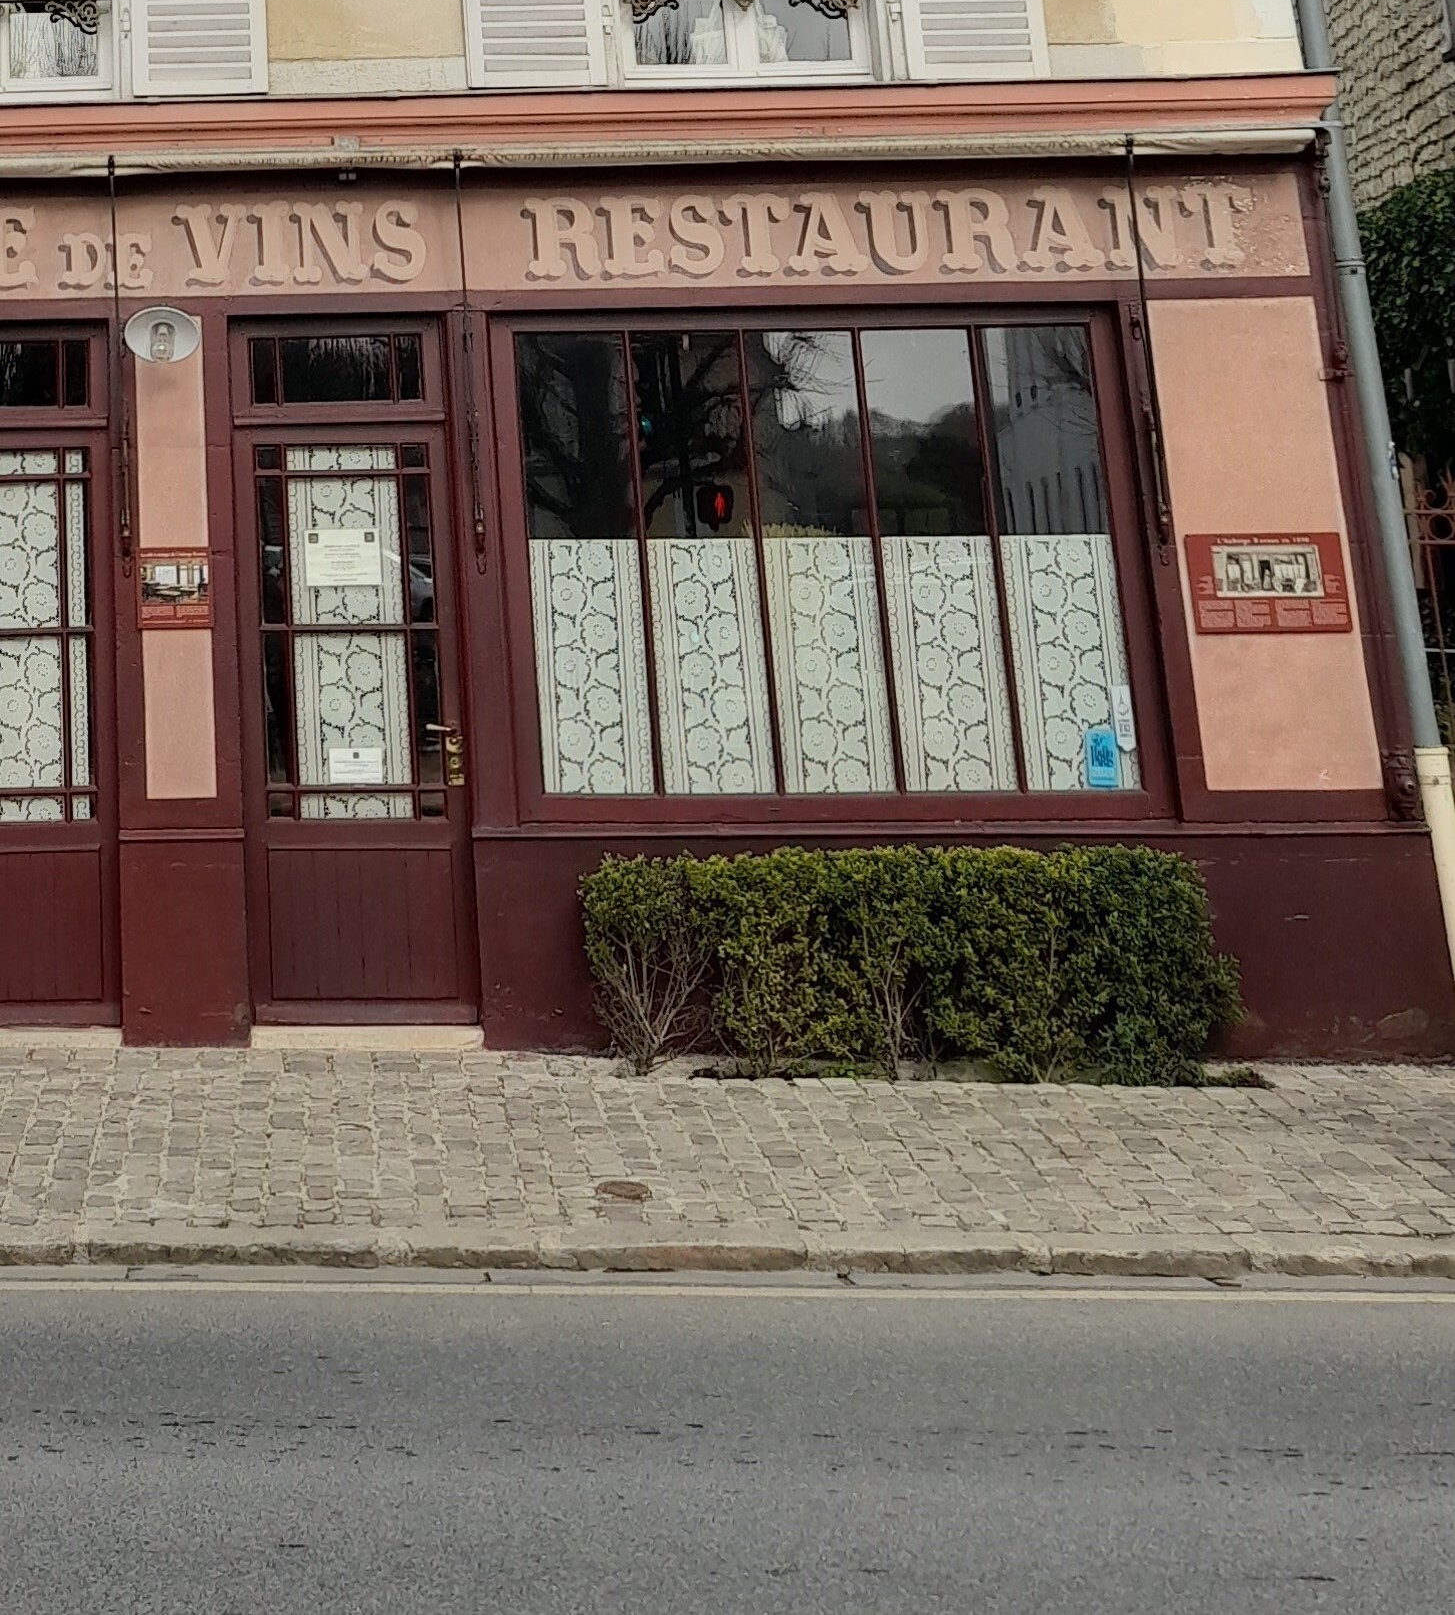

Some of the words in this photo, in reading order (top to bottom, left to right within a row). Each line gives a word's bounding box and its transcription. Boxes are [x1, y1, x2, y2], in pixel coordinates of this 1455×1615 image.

[58, 231, 154, 291] DE
[173, 198, 428, 287] VINS
[521, 185, 1248, 283] RESTAURANT
